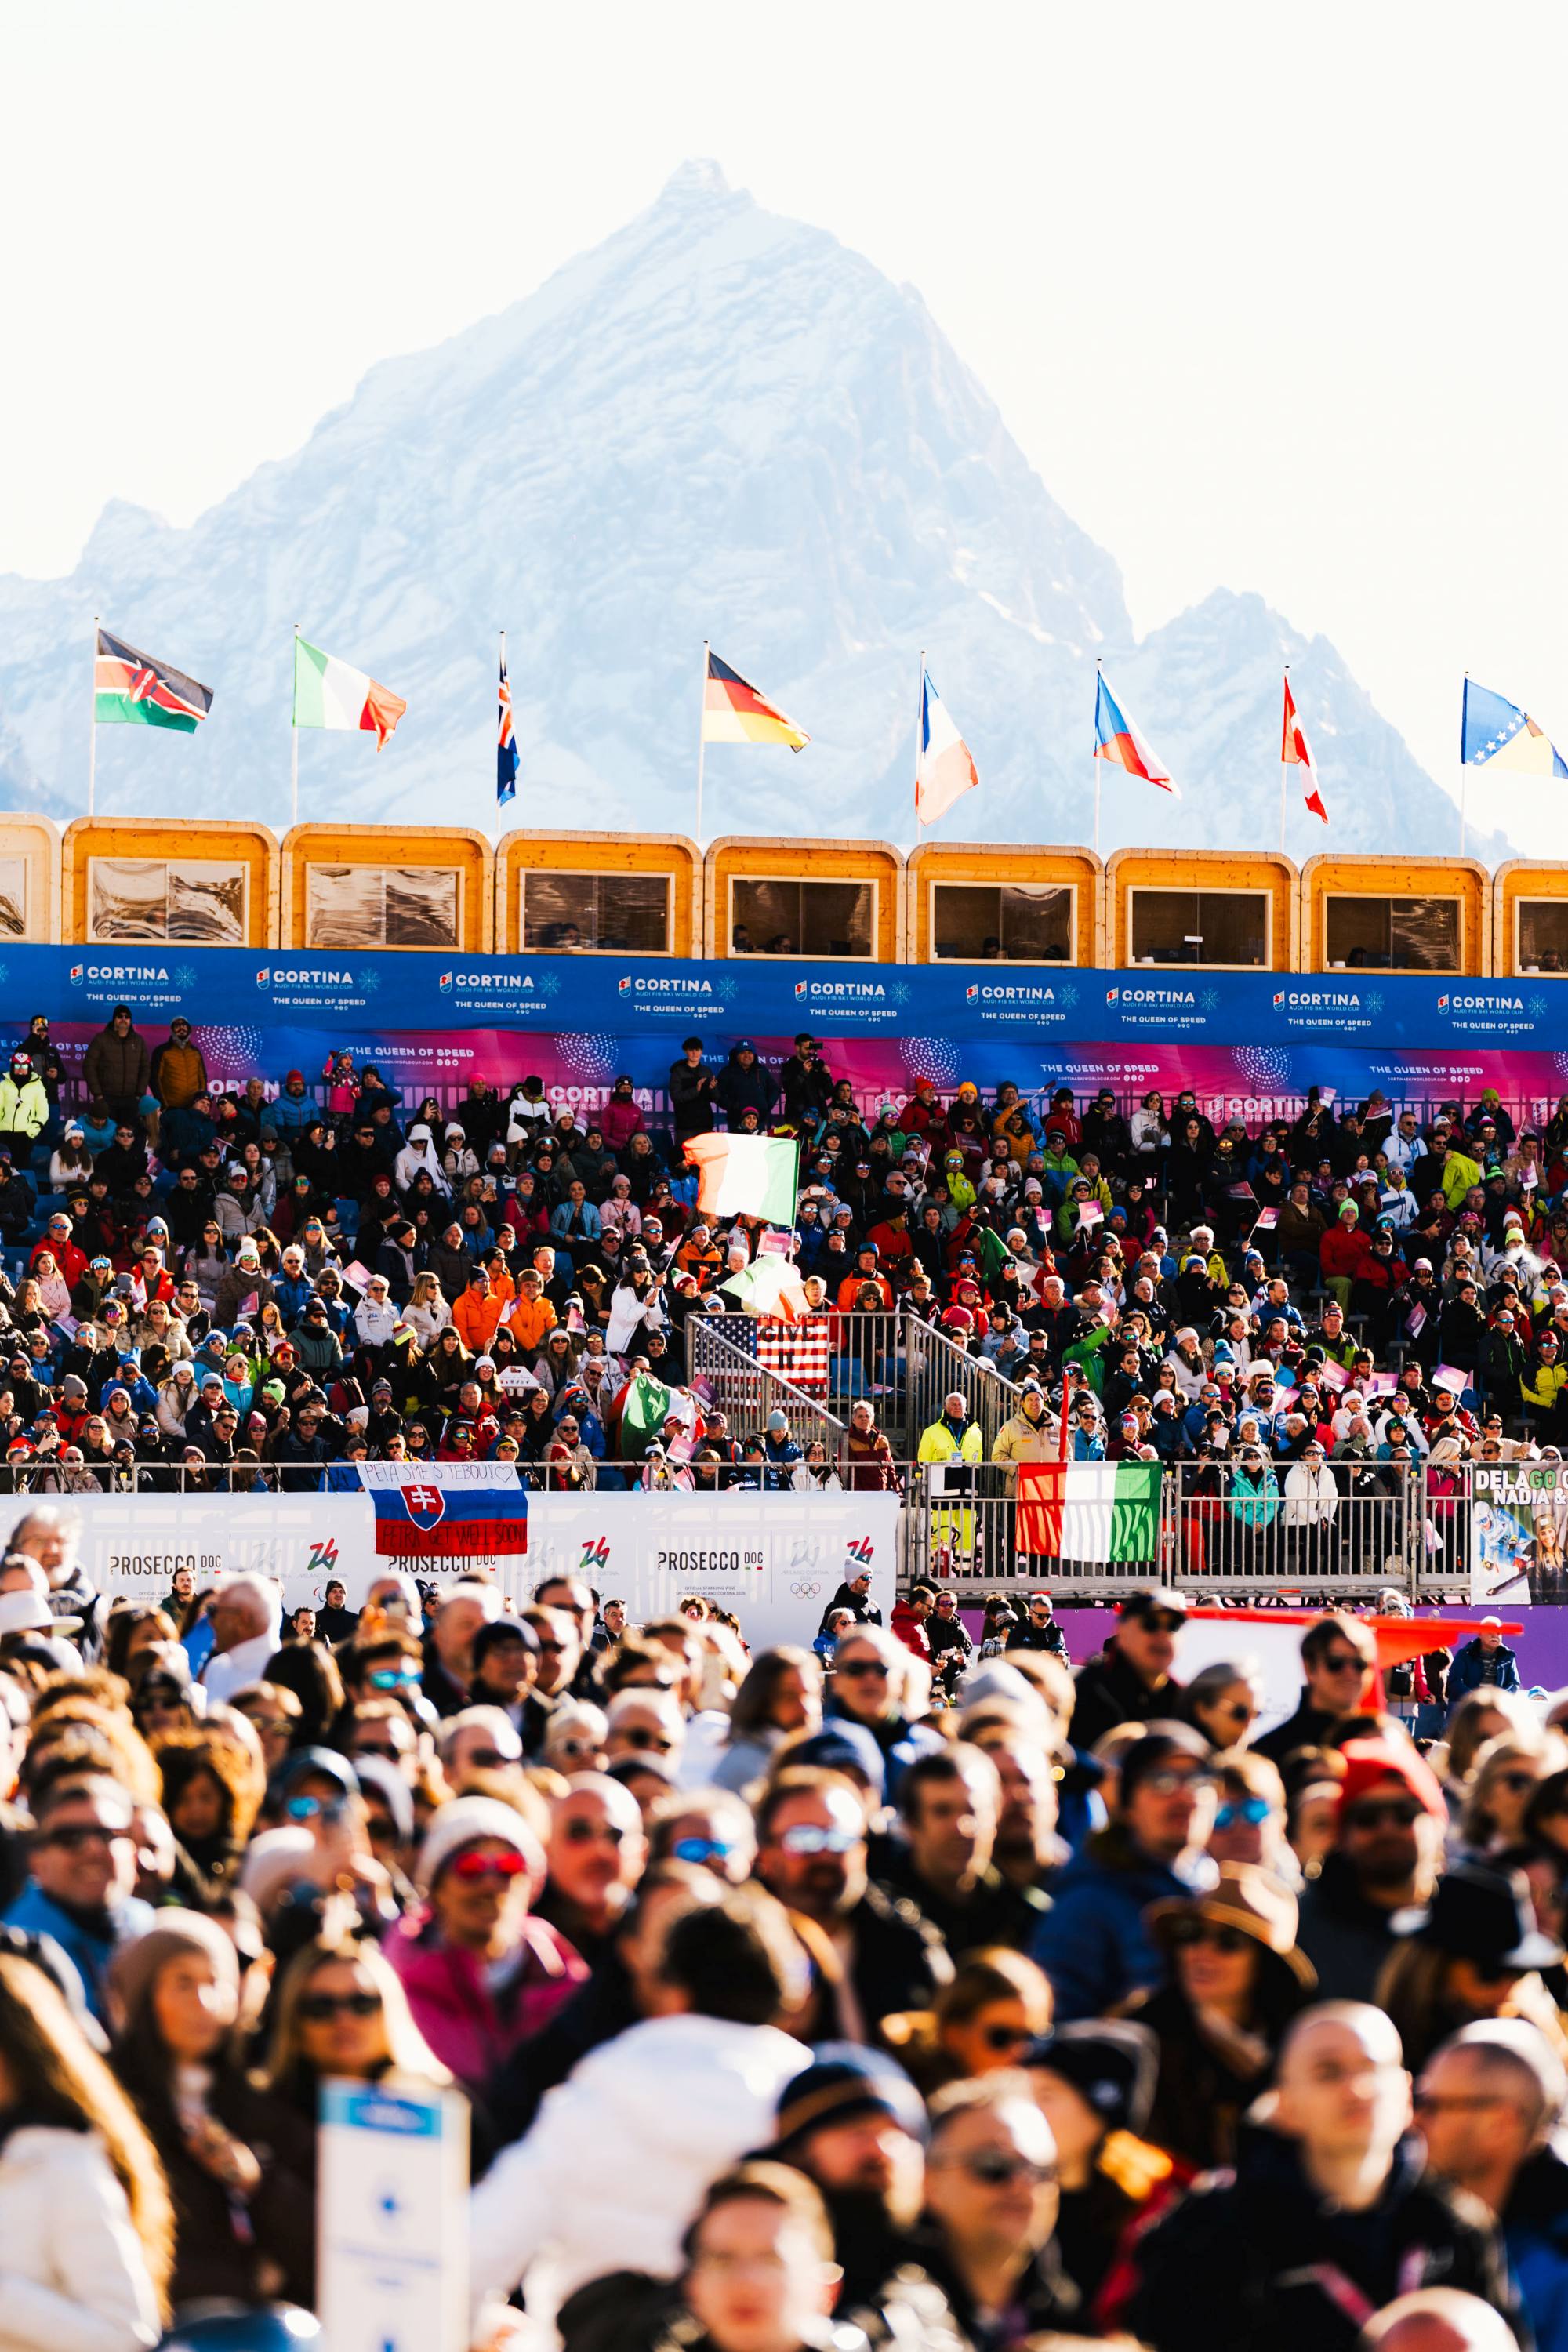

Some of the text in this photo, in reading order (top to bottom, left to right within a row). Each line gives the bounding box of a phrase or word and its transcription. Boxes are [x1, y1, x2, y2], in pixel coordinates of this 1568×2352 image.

[87, 967, 169, 980] CORTINA
[274, 971, 353, 984] CORTINA
[456, 975, 534, 988] CORTINA
[635, 978, 712, 992] CORTINA
[811, 983, 885, 996] CORTINA
[982, 987, 1054, 1000] CORTINA
[1122, 990, 1195, 1003] CORTINA
[1289, 993, 1360, 1006] CORTINA
[1453, 996, 1523, 1009] CORTINA
[375, 1047, 415, 1056] QUEEN
[550, 1086, 653, 1103] CORTA
[760, 1323, 815, 1342] GIVE
[779, 1352, 794, 1369] IT
[405, 1464, 430, 1481] SME
[1475, 1469, 1556, 1490] DELAGO
[1494, 1487, 1566, 1505] NADIA &
[382, 1525, 420, 1548] PETRA
[429, 1526, 451, 1545] GET
[456, 1523, 490, 1545] WELL
[110, 1555, 221, 1575] PROSECCO DOC
[389, 1555, 470, 1573] PROSECCO
[658, 1552, 763, 1570] PROSECCO DOC
